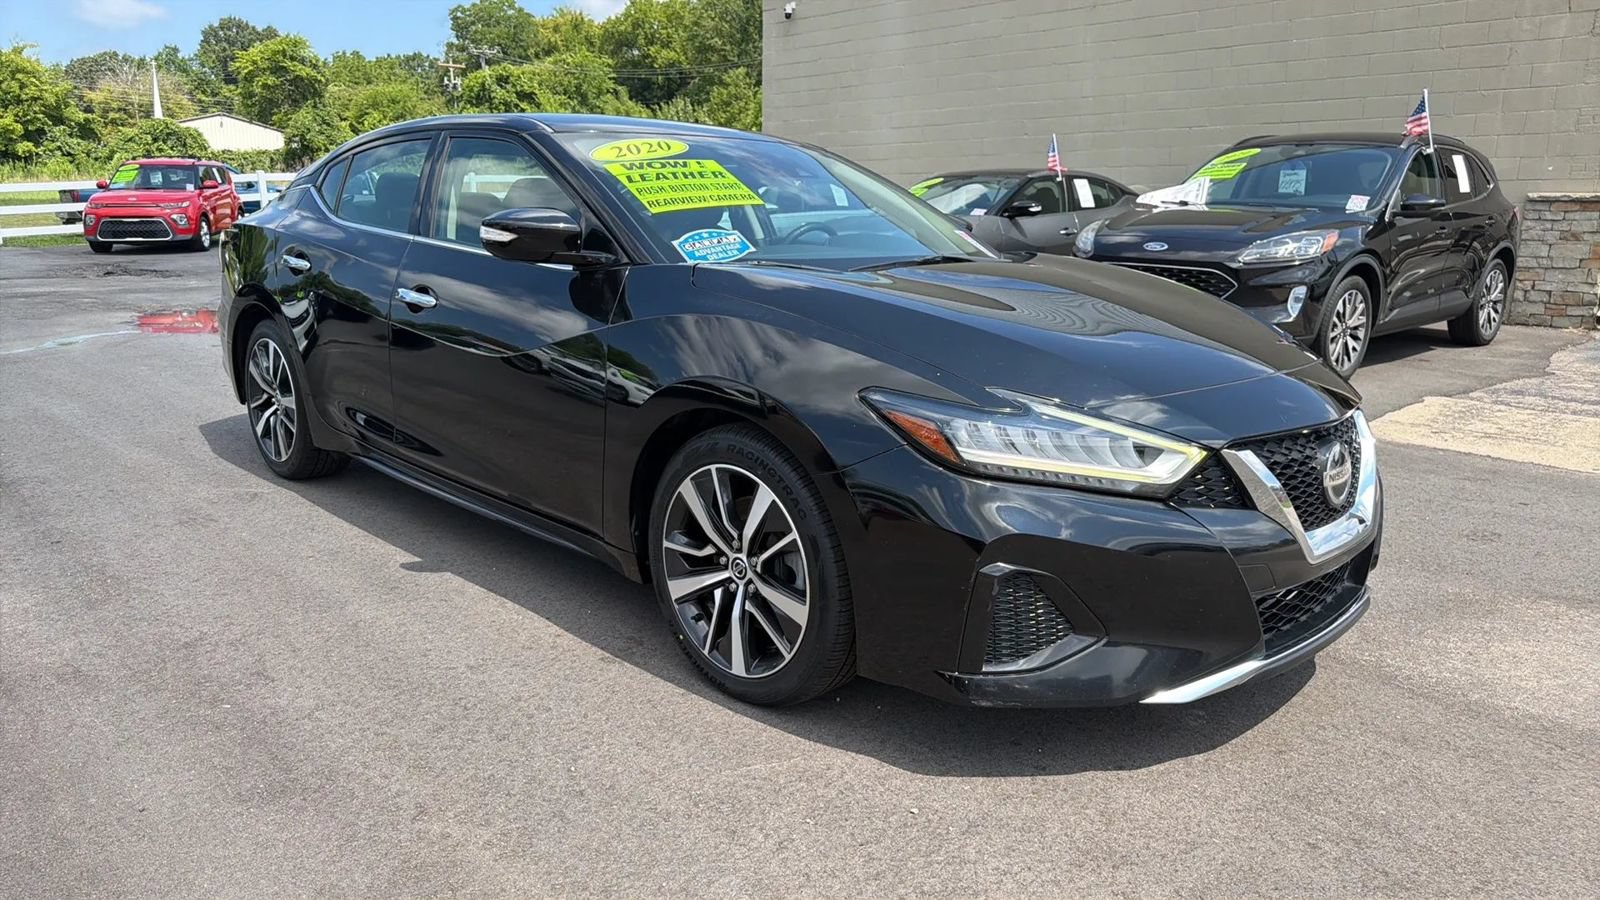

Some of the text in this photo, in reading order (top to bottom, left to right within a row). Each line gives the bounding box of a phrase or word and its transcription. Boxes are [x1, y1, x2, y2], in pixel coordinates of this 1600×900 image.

[610, 141, 671, 158] 2020
[620, 161, 705, 171] WOW !
[625, 171, 727, 184] LEATHER
[636, 183, 741, 196] PUSH BUTTON START
[648, 194, 755, 208] REARVIEW CAMERA
[706, 250, 741, 261] DEALER
